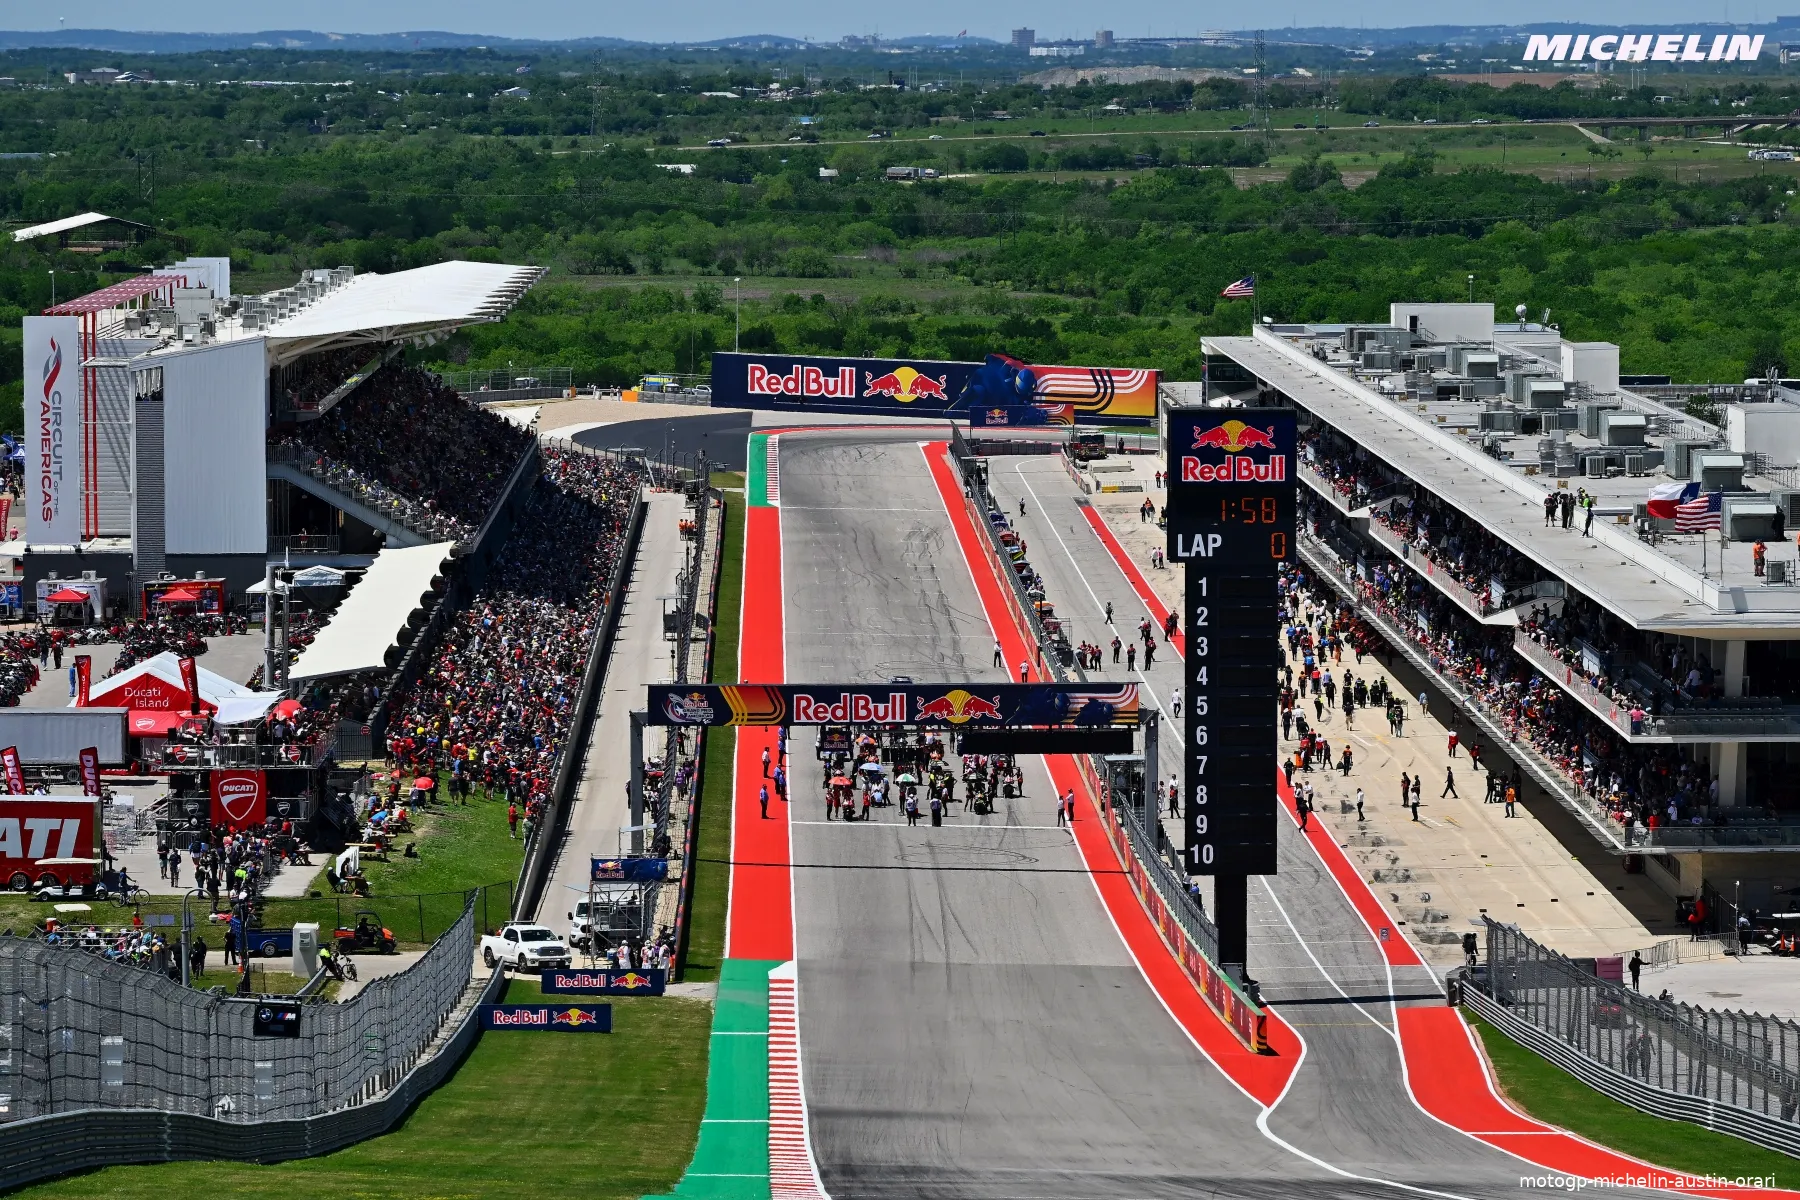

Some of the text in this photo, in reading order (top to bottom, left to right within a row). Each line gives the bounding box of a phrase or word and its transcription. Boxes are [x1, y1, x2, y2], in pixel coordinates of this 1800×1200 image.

[748, 363, 856, 398] Red Bull
[52, 390, 62, 480] CIRCUIT
[40, 400, 52, 522] AMERICAS
[1181, 455, 1286, 482] Red Bull
[53, 481, 58, 493] OF
[1221, 497, 1276, 524] 1:58
[1177, 532, 1286, 558] LAP 0
[1198, 577, 1207, 597] 1
[1196, 606, 1208, 626] 2
[1196, 636, 1208, 656] 3
[1196, 666, 1208, 685] 4
[124, 687, 161, 697] Ducati
[135, 697, 169, 707] Island
[793, 692, 907, 723] Red Bull
[1196, 696, 1208, 715] 5
[1196, 725, 1208, 745] 6
[1196, 755, 1208, 774] 7
[1196, 785, 1208, 805] 8
[1196, 814, 1208, 834] 9
[1190, 844, 1214, 864] 10
[555, 973, 606, 988] Red Bull
[493, 1009, 548, 1024] Red Bull
